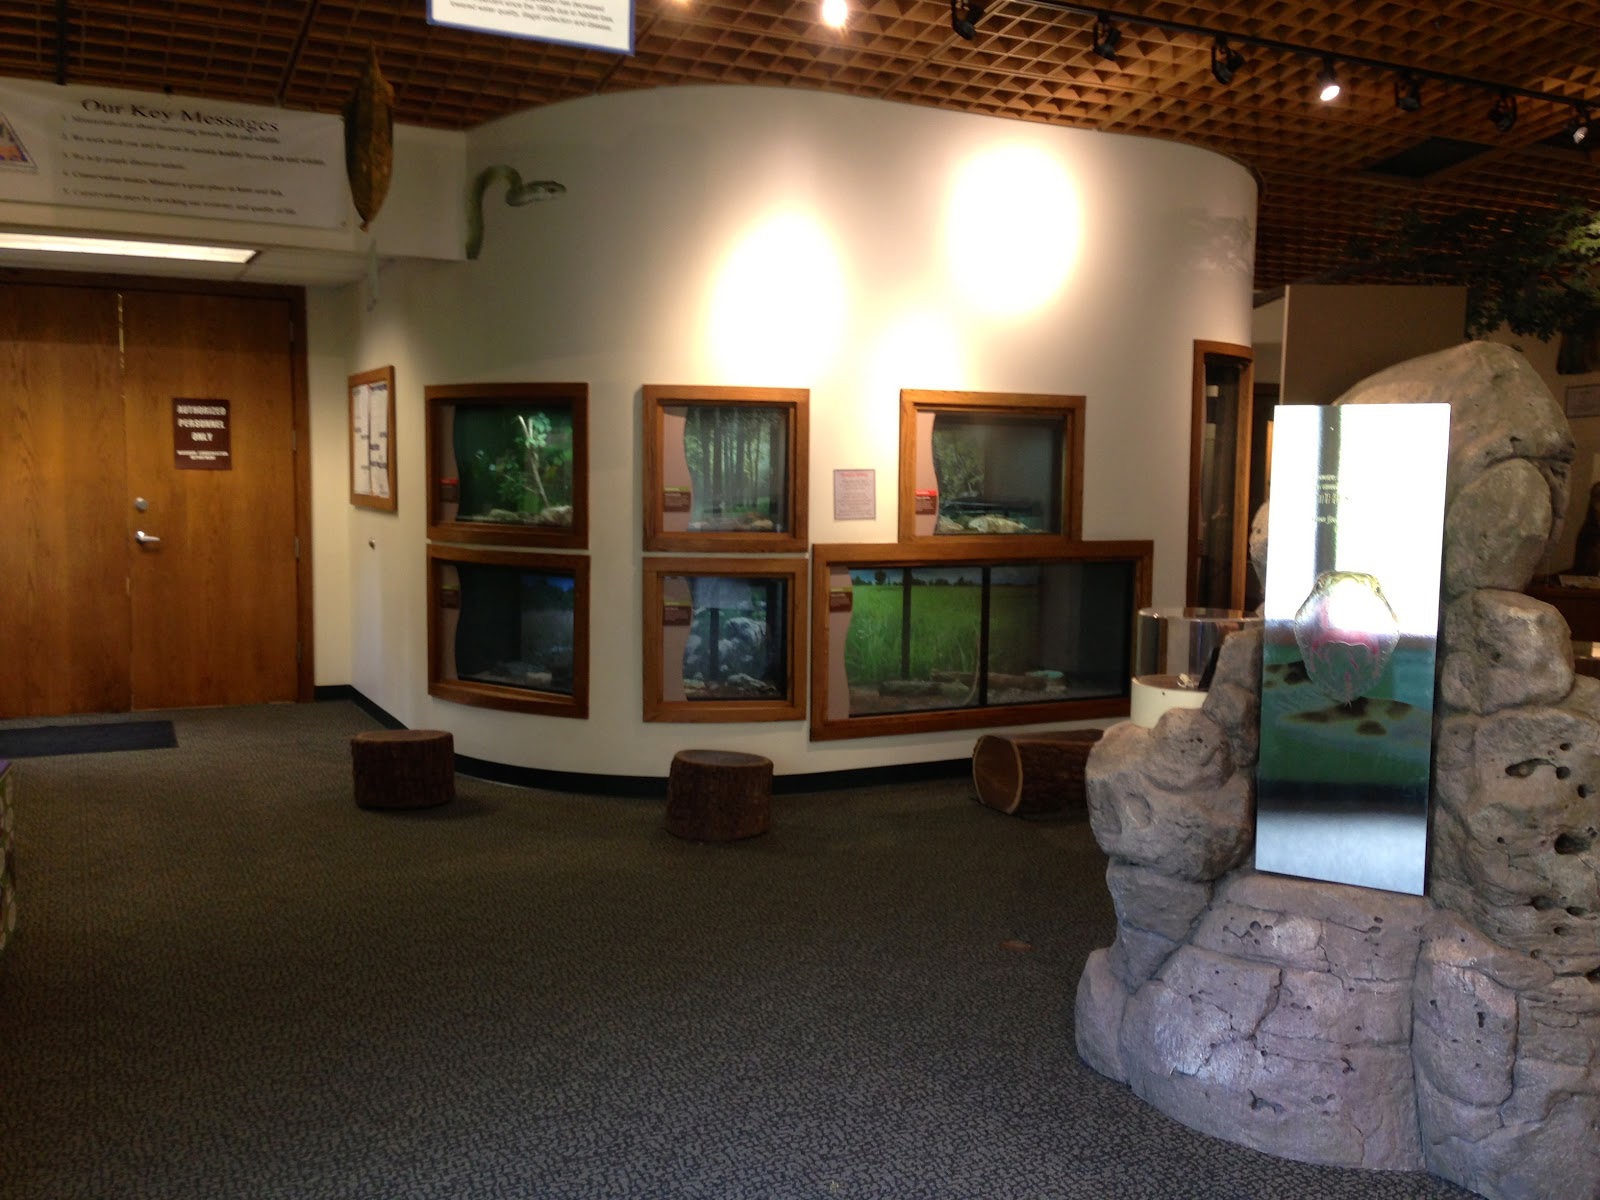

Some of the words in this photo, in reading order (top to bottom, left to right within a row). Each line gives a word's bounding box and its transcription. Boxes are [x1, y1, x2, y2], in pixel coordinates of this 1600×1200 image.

[81, 98, 123, 115] Our
[130, 104, 174, 124] Key
[181, 109, 280, 134] Messages
